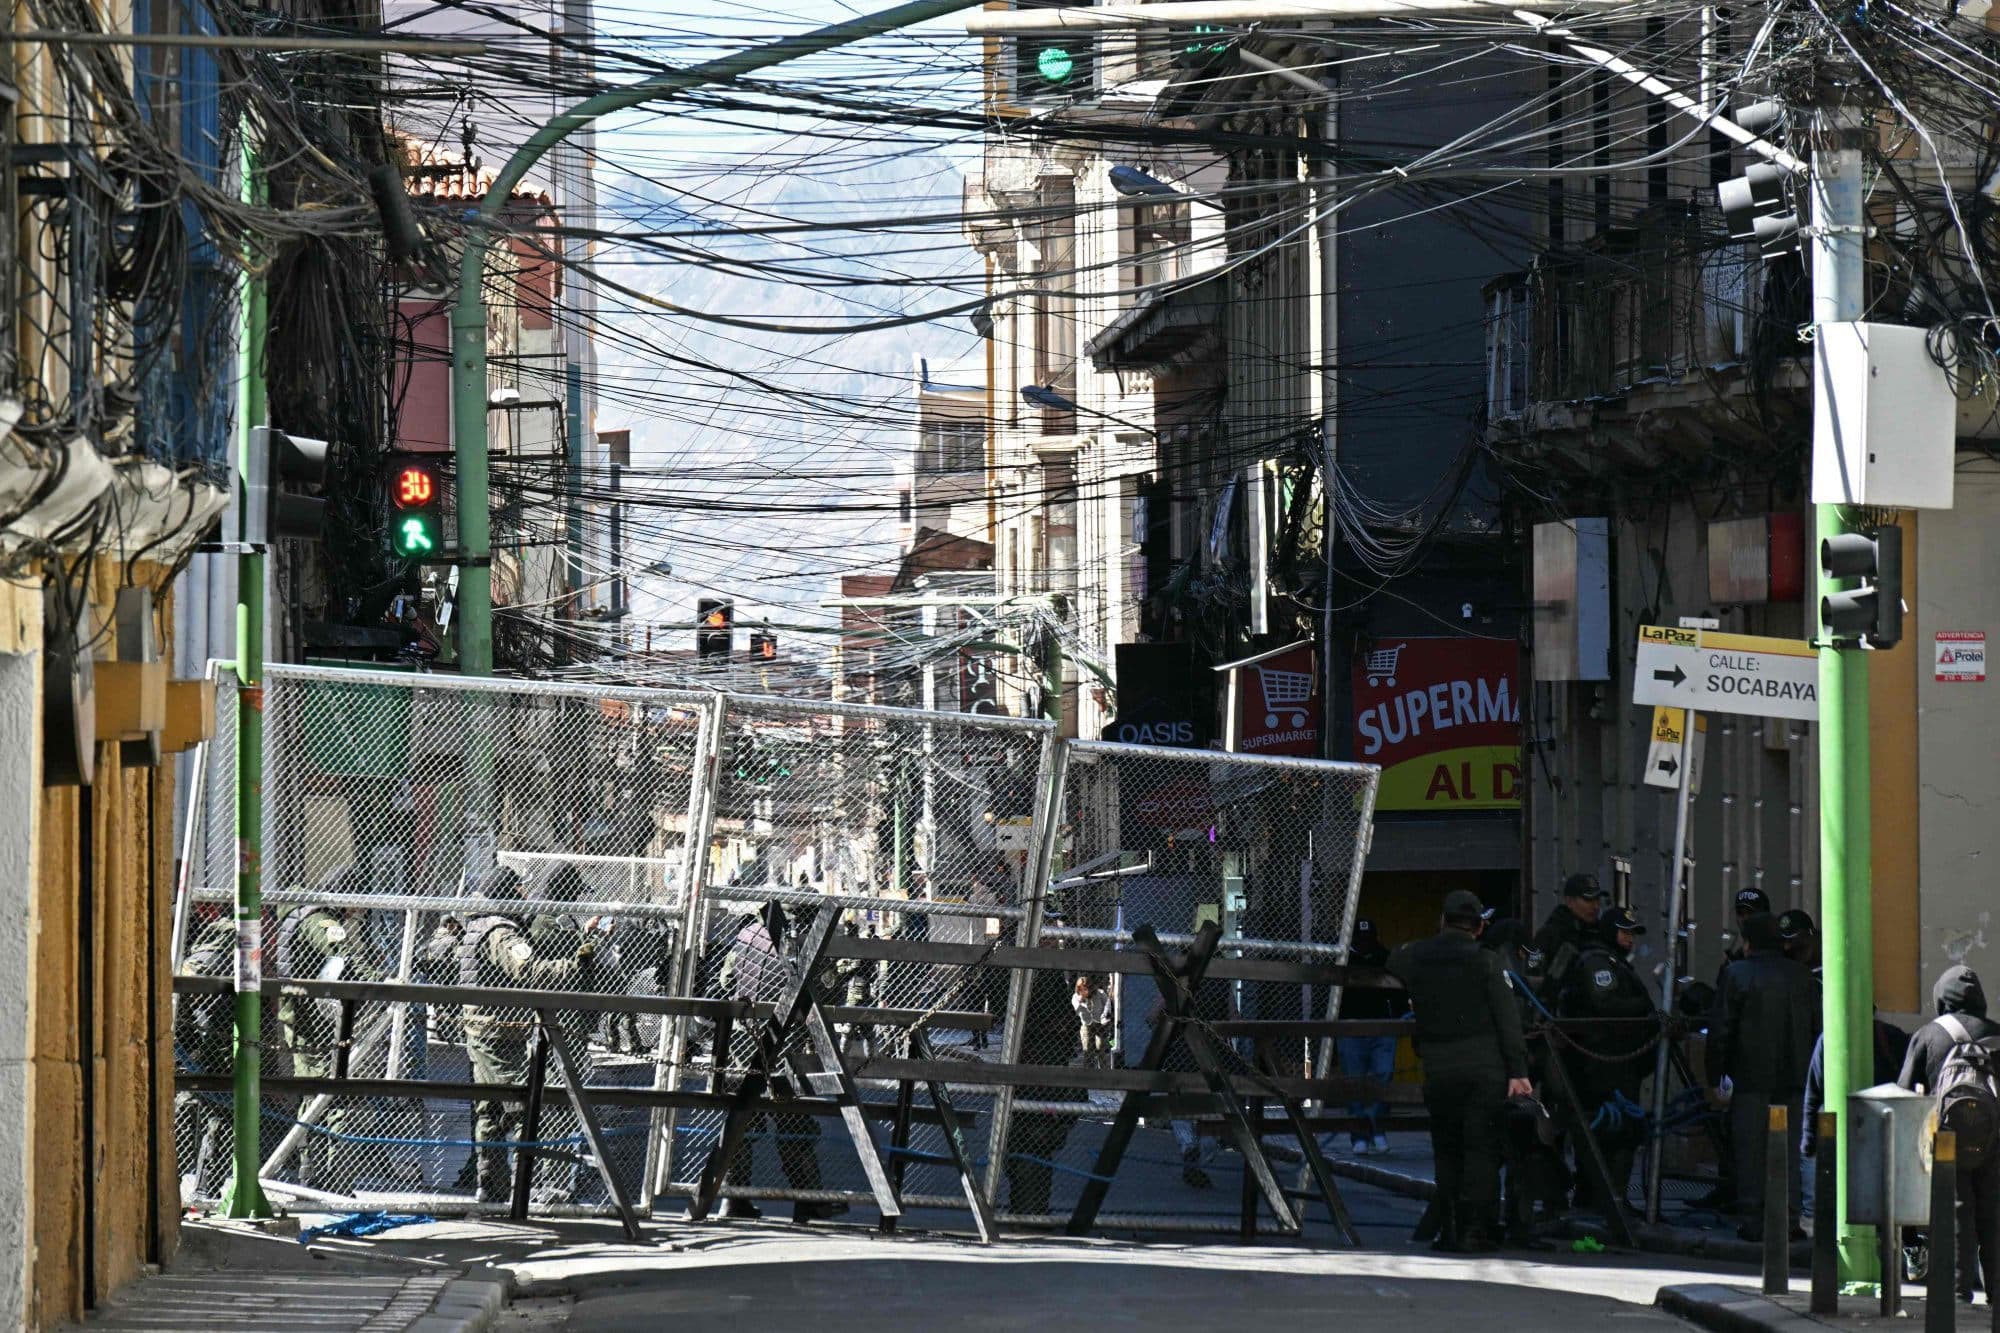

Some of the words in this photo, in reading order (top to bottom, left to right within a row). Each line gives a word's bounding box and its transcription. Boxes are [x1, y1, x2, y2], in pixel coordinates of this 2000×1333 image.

[401, 470, 430, 500] 30
[1709, 654, 1760, 671] CALLE:
[1706, 674, 1817, 701] SOCABAYA
[1119, 721, 1194, 744] OASIS
[1242, 729, 1318, 750] SUPERMARKET
